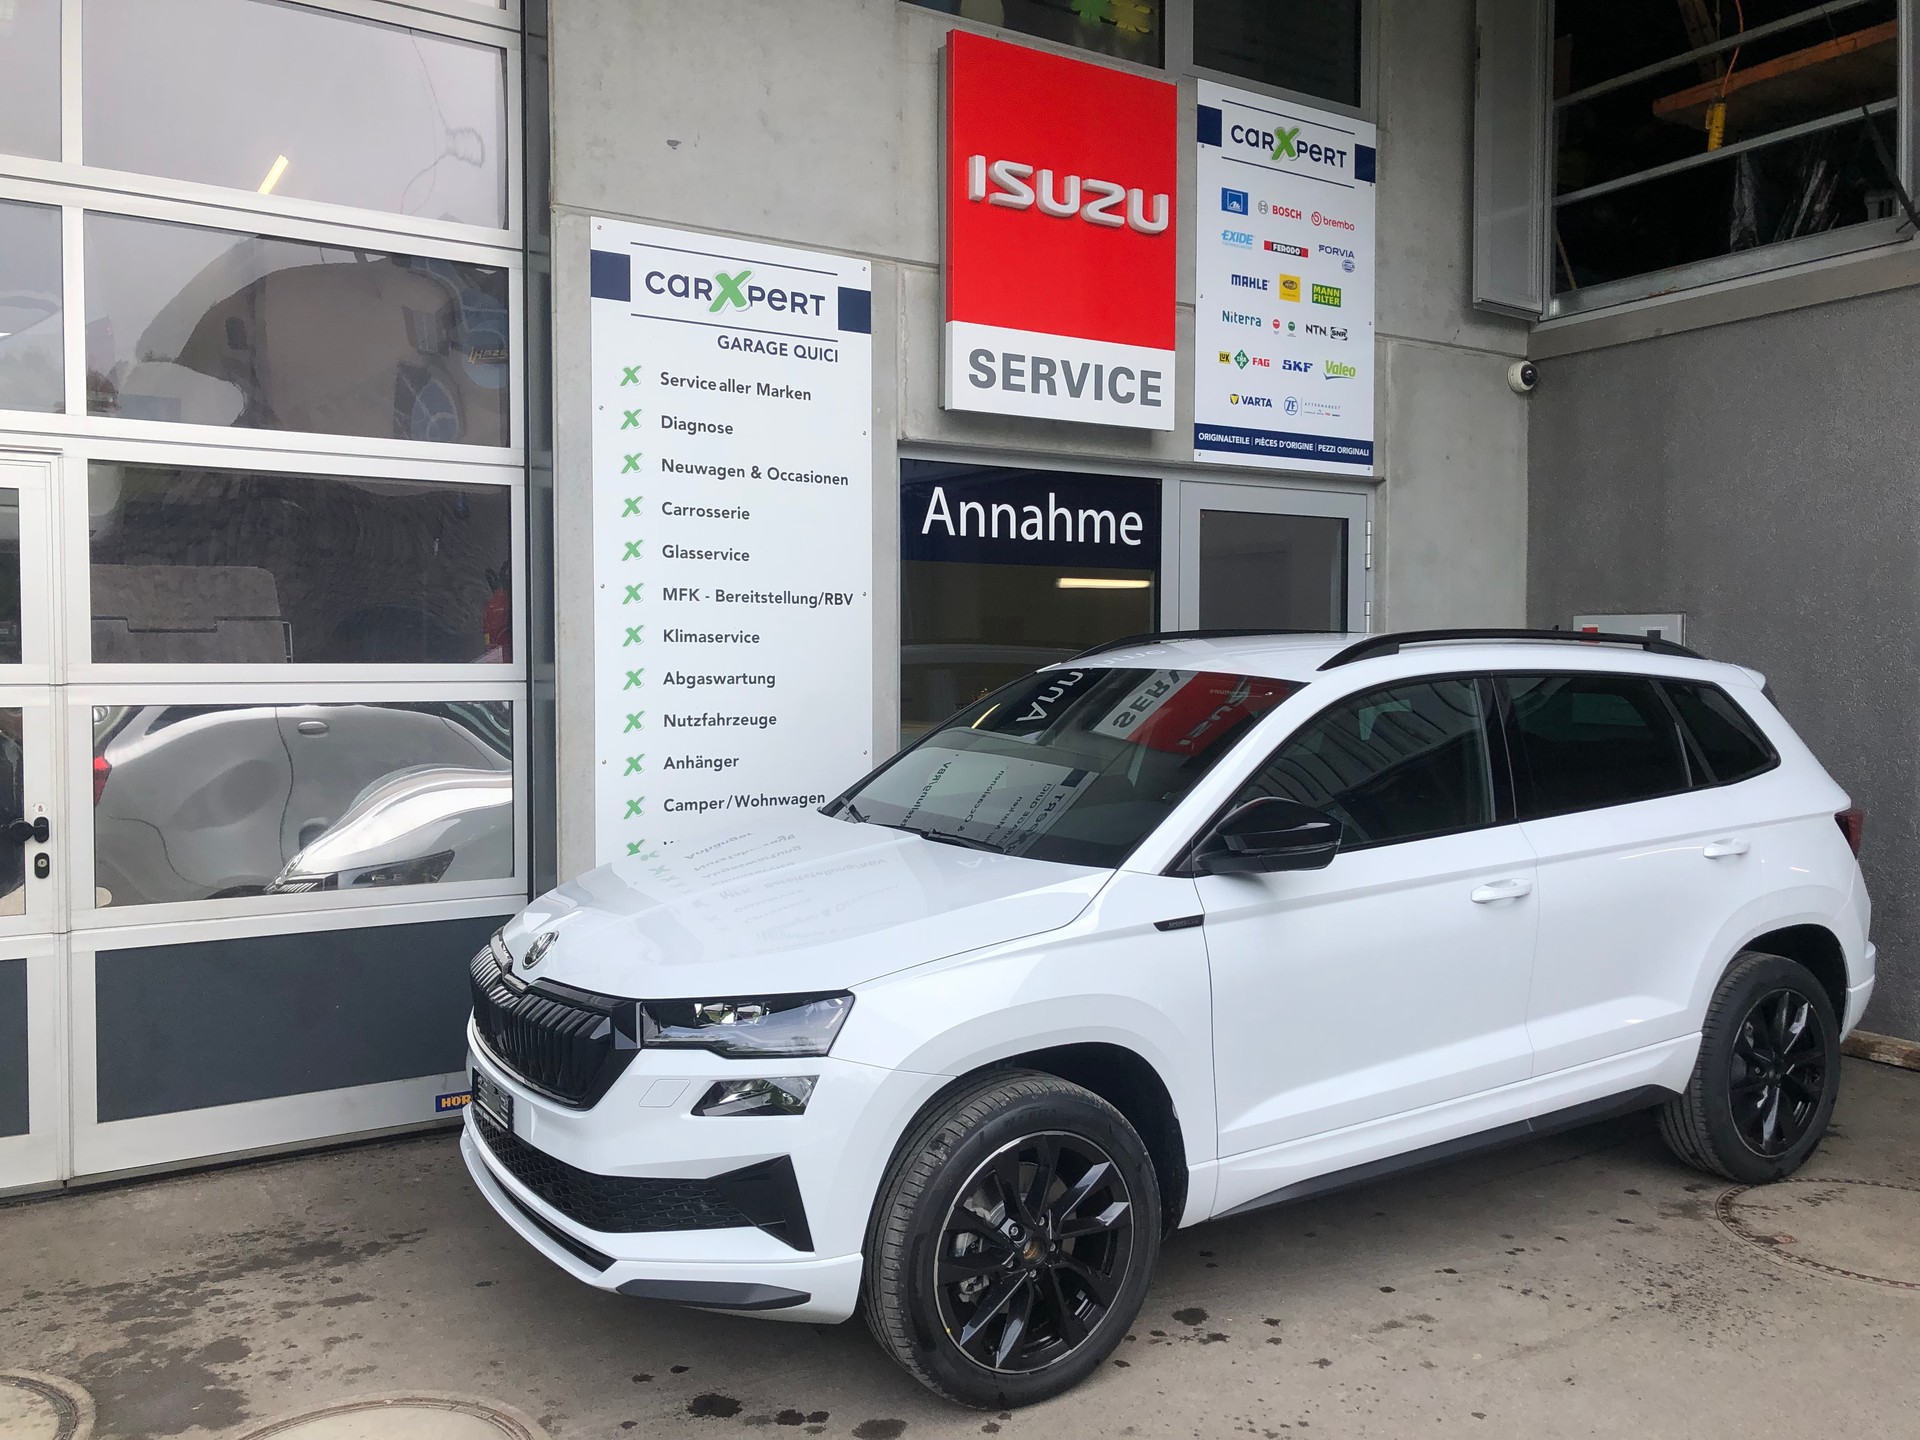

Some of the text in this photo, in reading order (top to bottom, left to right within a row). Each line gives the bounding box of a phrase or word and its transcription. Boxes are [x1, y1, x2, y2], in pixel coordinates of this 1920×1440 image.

[968, 154, 1169, 234] ISUZU
[1272, 204, 1302, 220] BOSCH
[1323, 216, 1355, 231] brembo
[1222, 229, 1253, 245] EXIDE
[1272, 243, 1301, 256] FERODO
[1319, 244, 1355, 259] FORVIA
[1231, 273, 1268, 291] MAHLE
[1313, 285, 1340, 297] MANN
[1313, 293, 1340, 306] FILTER
[1222, 310, 1262, 328] Niterra
[1305, 324, 1327, 337] NTN
[1331, 329, 1347, 338] SNR
[717, 335, 839, 363] GARAGE QUICI
[1252, 357, 1270, 368] FAG
[1282, 359, 1314, 373] SKF
[660, 371, 811, 401] Service aller Marken
[968, 348, 1162, 407] SERVICE
[1241, 395, 1273, 408] VARTA
[661, 415, 734, 436] Diagnose
[1198, 432, 1250, 445] ORIGINALTEILE
[1254, 436, 1278, 448] PIÈCES
[1317, 444, 1336, 454] PEZZI
[1336, 447, 1370, 457] ORIGINALI
[661, 458, 849, 486] Neuwagen & Occasionen
[661, 502, 750, 520] Carrosserie
[921, 486, 1143, 546] Annahme
[662, 544, 750, 562] Glasservice
[662, 588, 701, 602] MFK
[715, 589, 854, 609] Bereitstellung/RBV
[663, 628, 760, 644] Klimaservice
[663, 671, 776, 689] Abgaswartung
[663, 712, 777, 730] Nutzfahrzeuge
[663, 754, 740, 772] Anhänger
